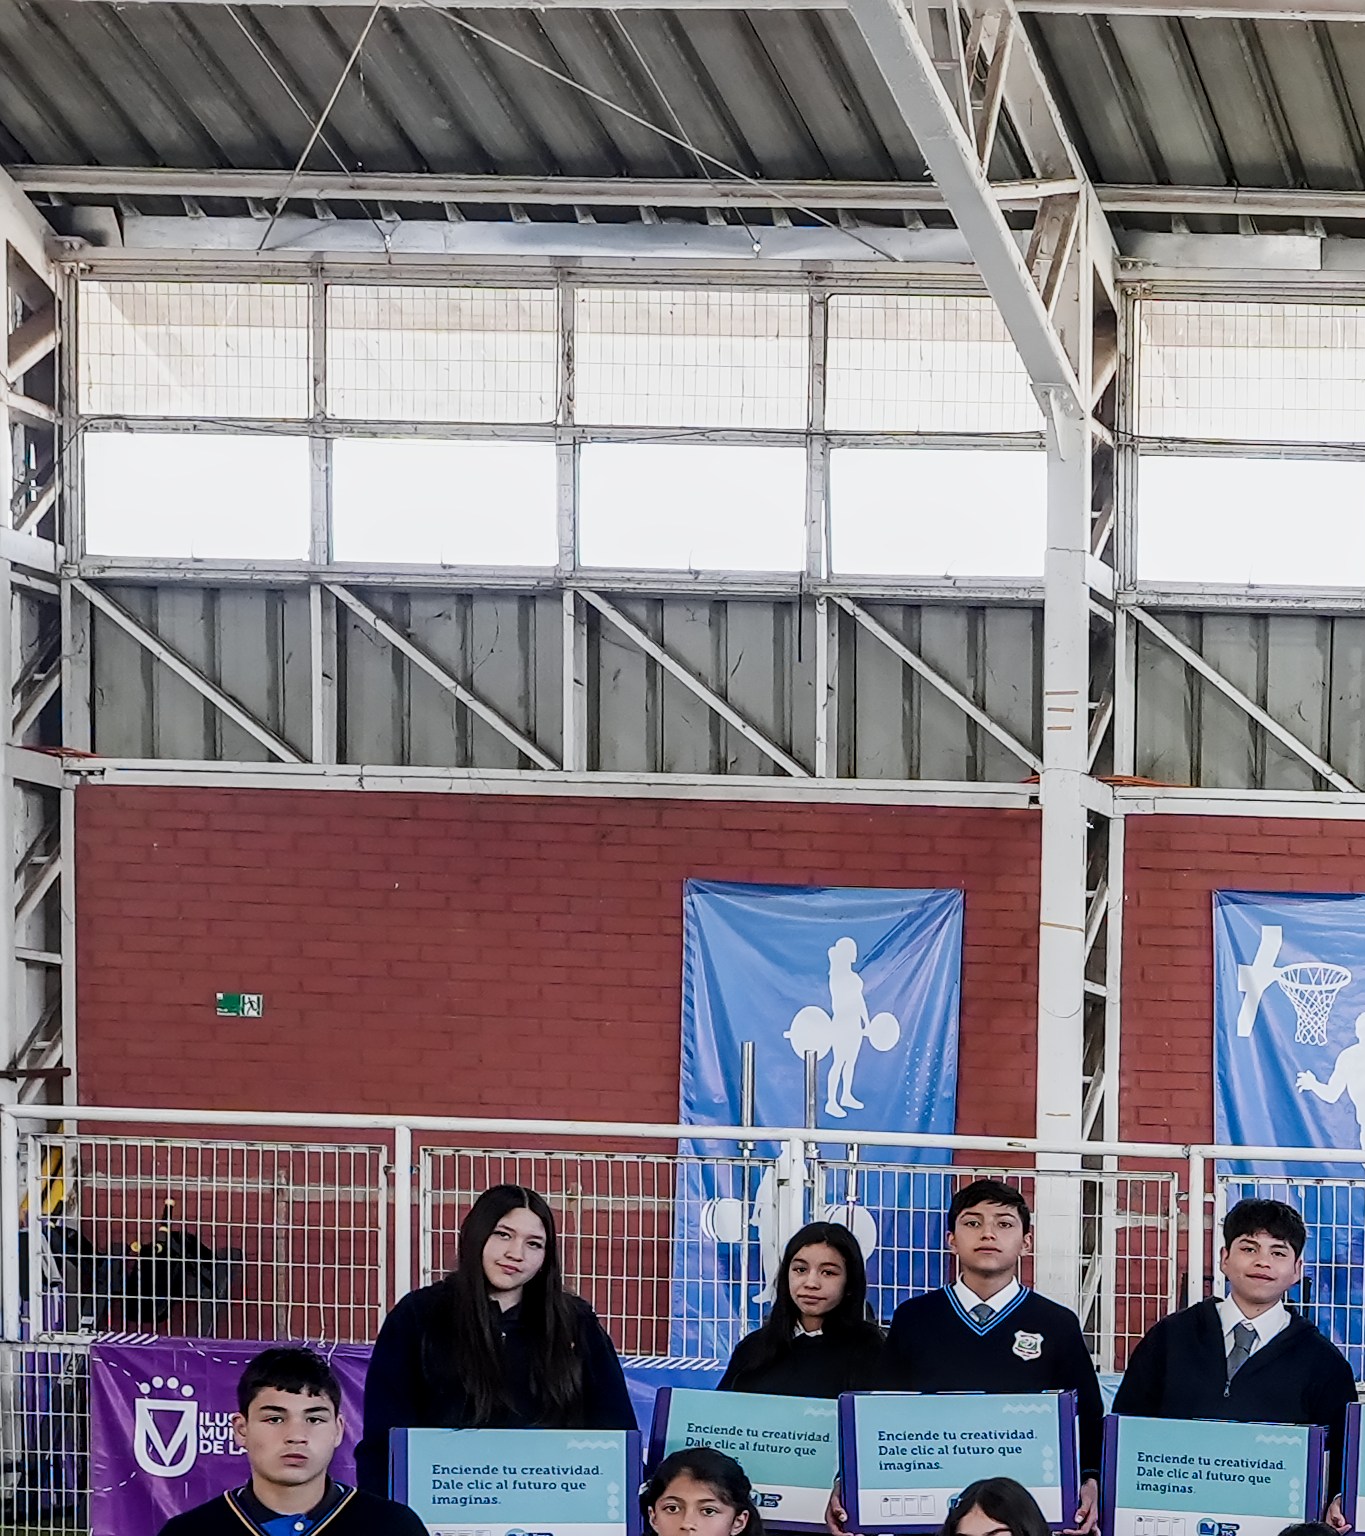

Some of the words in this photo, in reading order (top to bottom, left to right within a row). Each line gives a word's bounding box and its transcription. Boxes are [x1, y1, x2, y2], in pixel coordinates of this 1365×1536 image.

[199, 1440, 224, 1454] DE
[431, 1464, 499, 1475] Enciende
[502, 1465, 518, 1475] tu
[520, 1465, 604, 1476] creatividad.
